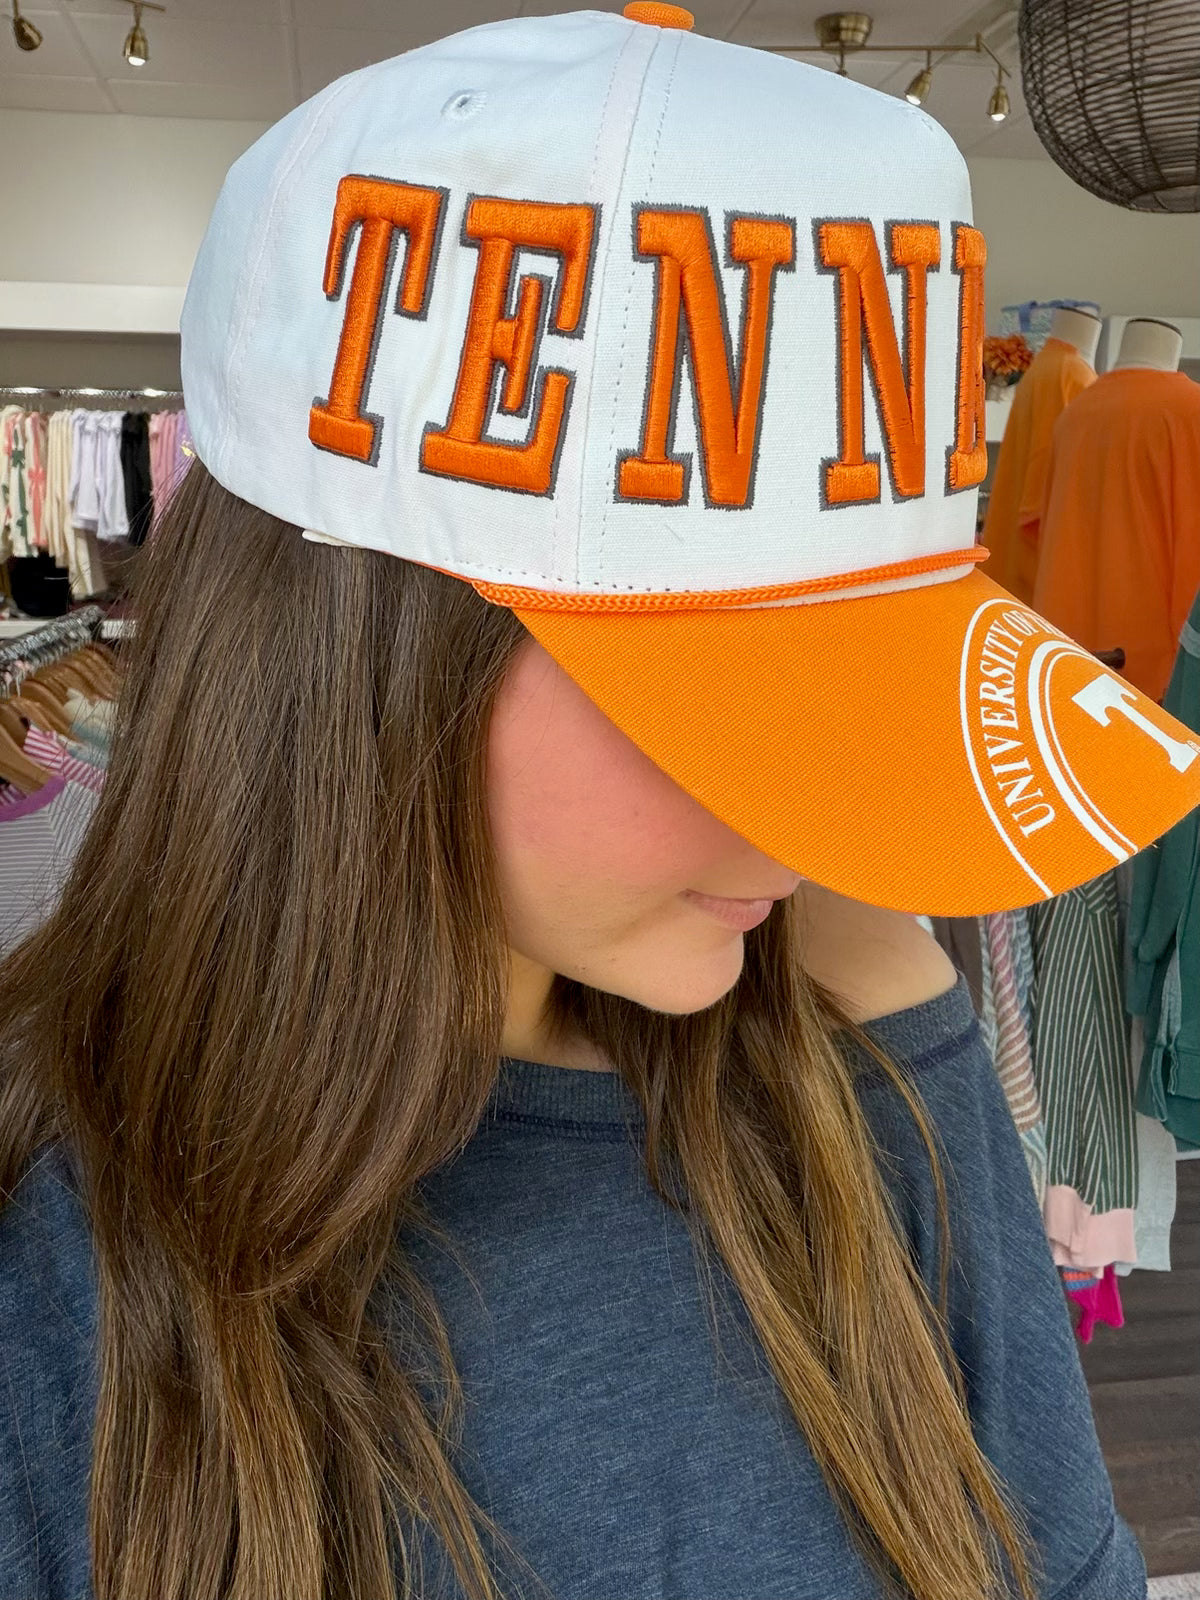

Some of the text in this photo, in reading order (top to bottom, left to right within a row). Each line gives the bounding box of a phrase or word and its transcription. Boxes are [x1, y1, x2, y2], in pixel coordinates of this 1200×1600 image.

[1002, 610, 1039, 636] OF
[979, 619, 1056, 838] UNIVERSITY
[1071, 673, 1199, 773] T
